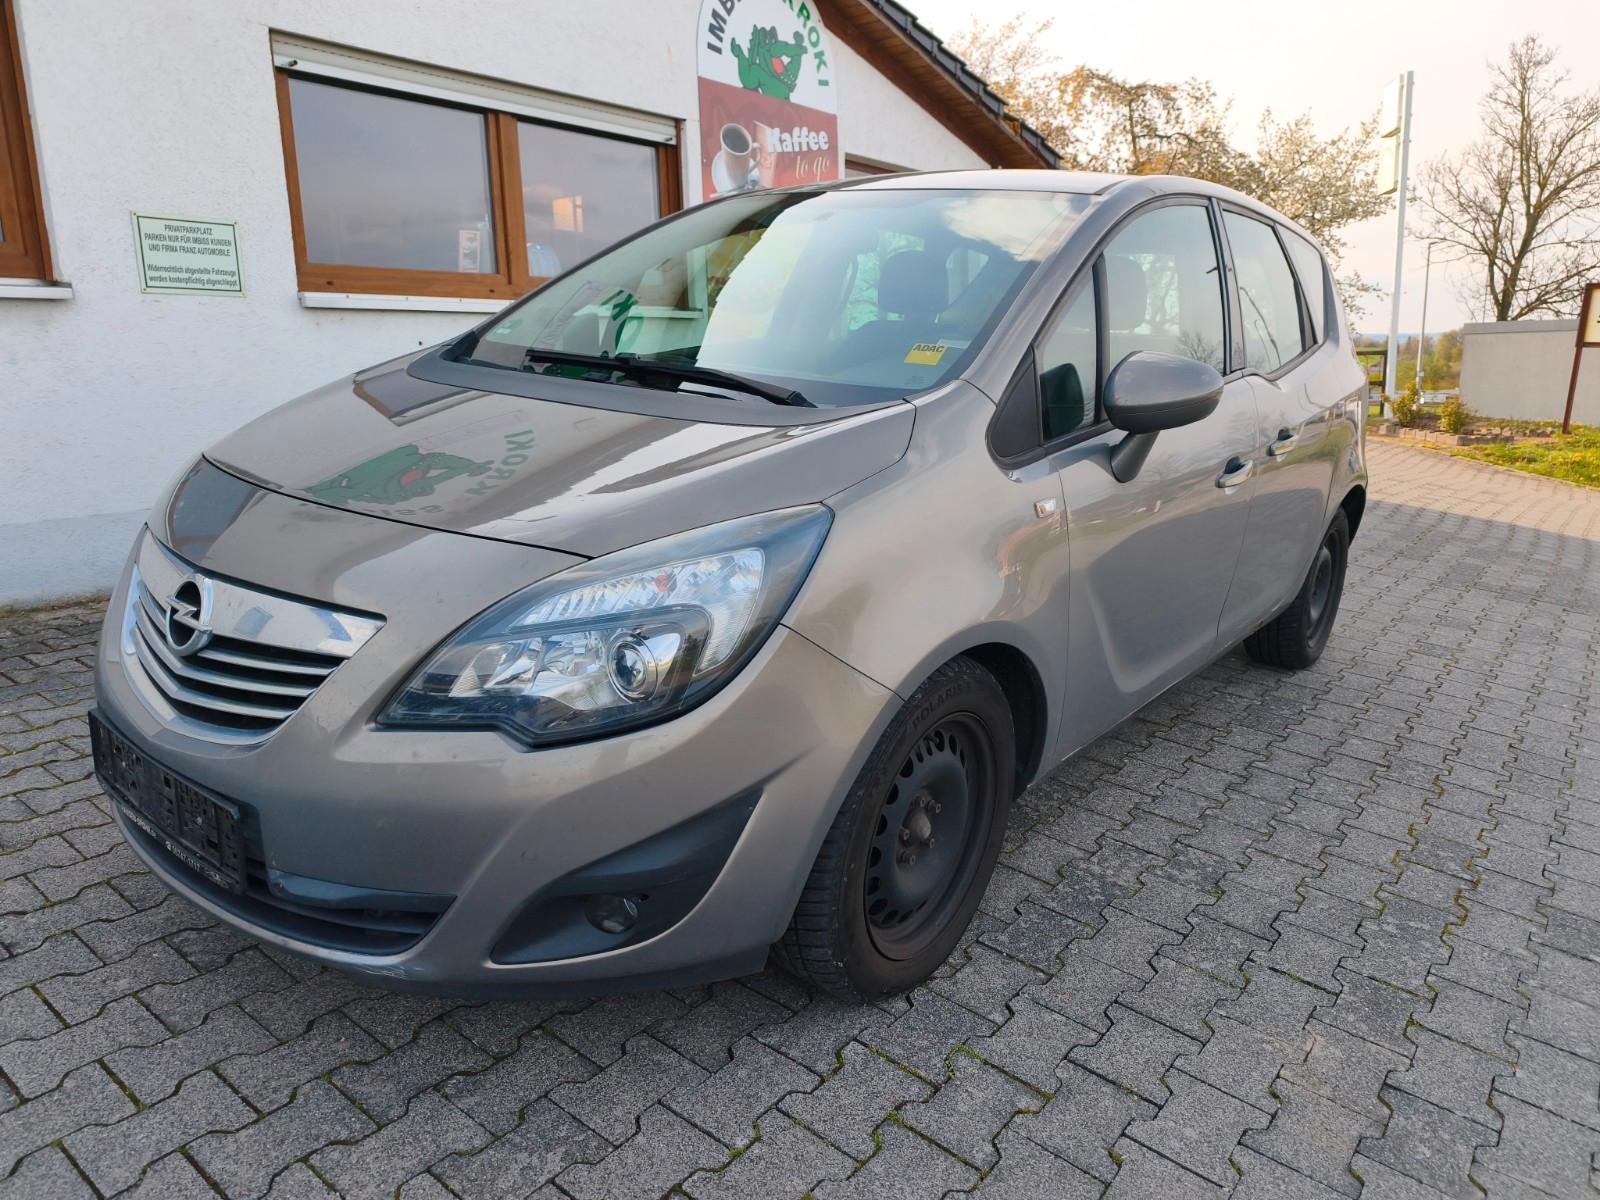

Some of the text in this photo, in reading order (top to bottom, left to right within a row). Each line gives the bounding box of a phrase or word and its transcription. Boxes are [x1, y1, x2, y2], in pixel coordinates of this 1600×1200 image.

[707, 0, 741, 55] IMB
[766, 126, 829, 153] Kaffee
[796, 156, 830, 182] to go
[164, 224, 213, 235] PRIVATPARKPLATZ
[144, 233, 232, 247] PARKEN NUR FÜR IMBISS KUNDEN
[148, 244, 231, 256] UND FIRMA FRANZ AUTOMOBILE
[147, 263, 184, 274] Widerrechtlich
[212, 267, 237, 278] Fahrzeuge
[149, 275, 168, 283] werden
[169, 275, 206, 286] kostenpflichtig
[912, 344, 945, 353] ADAC
